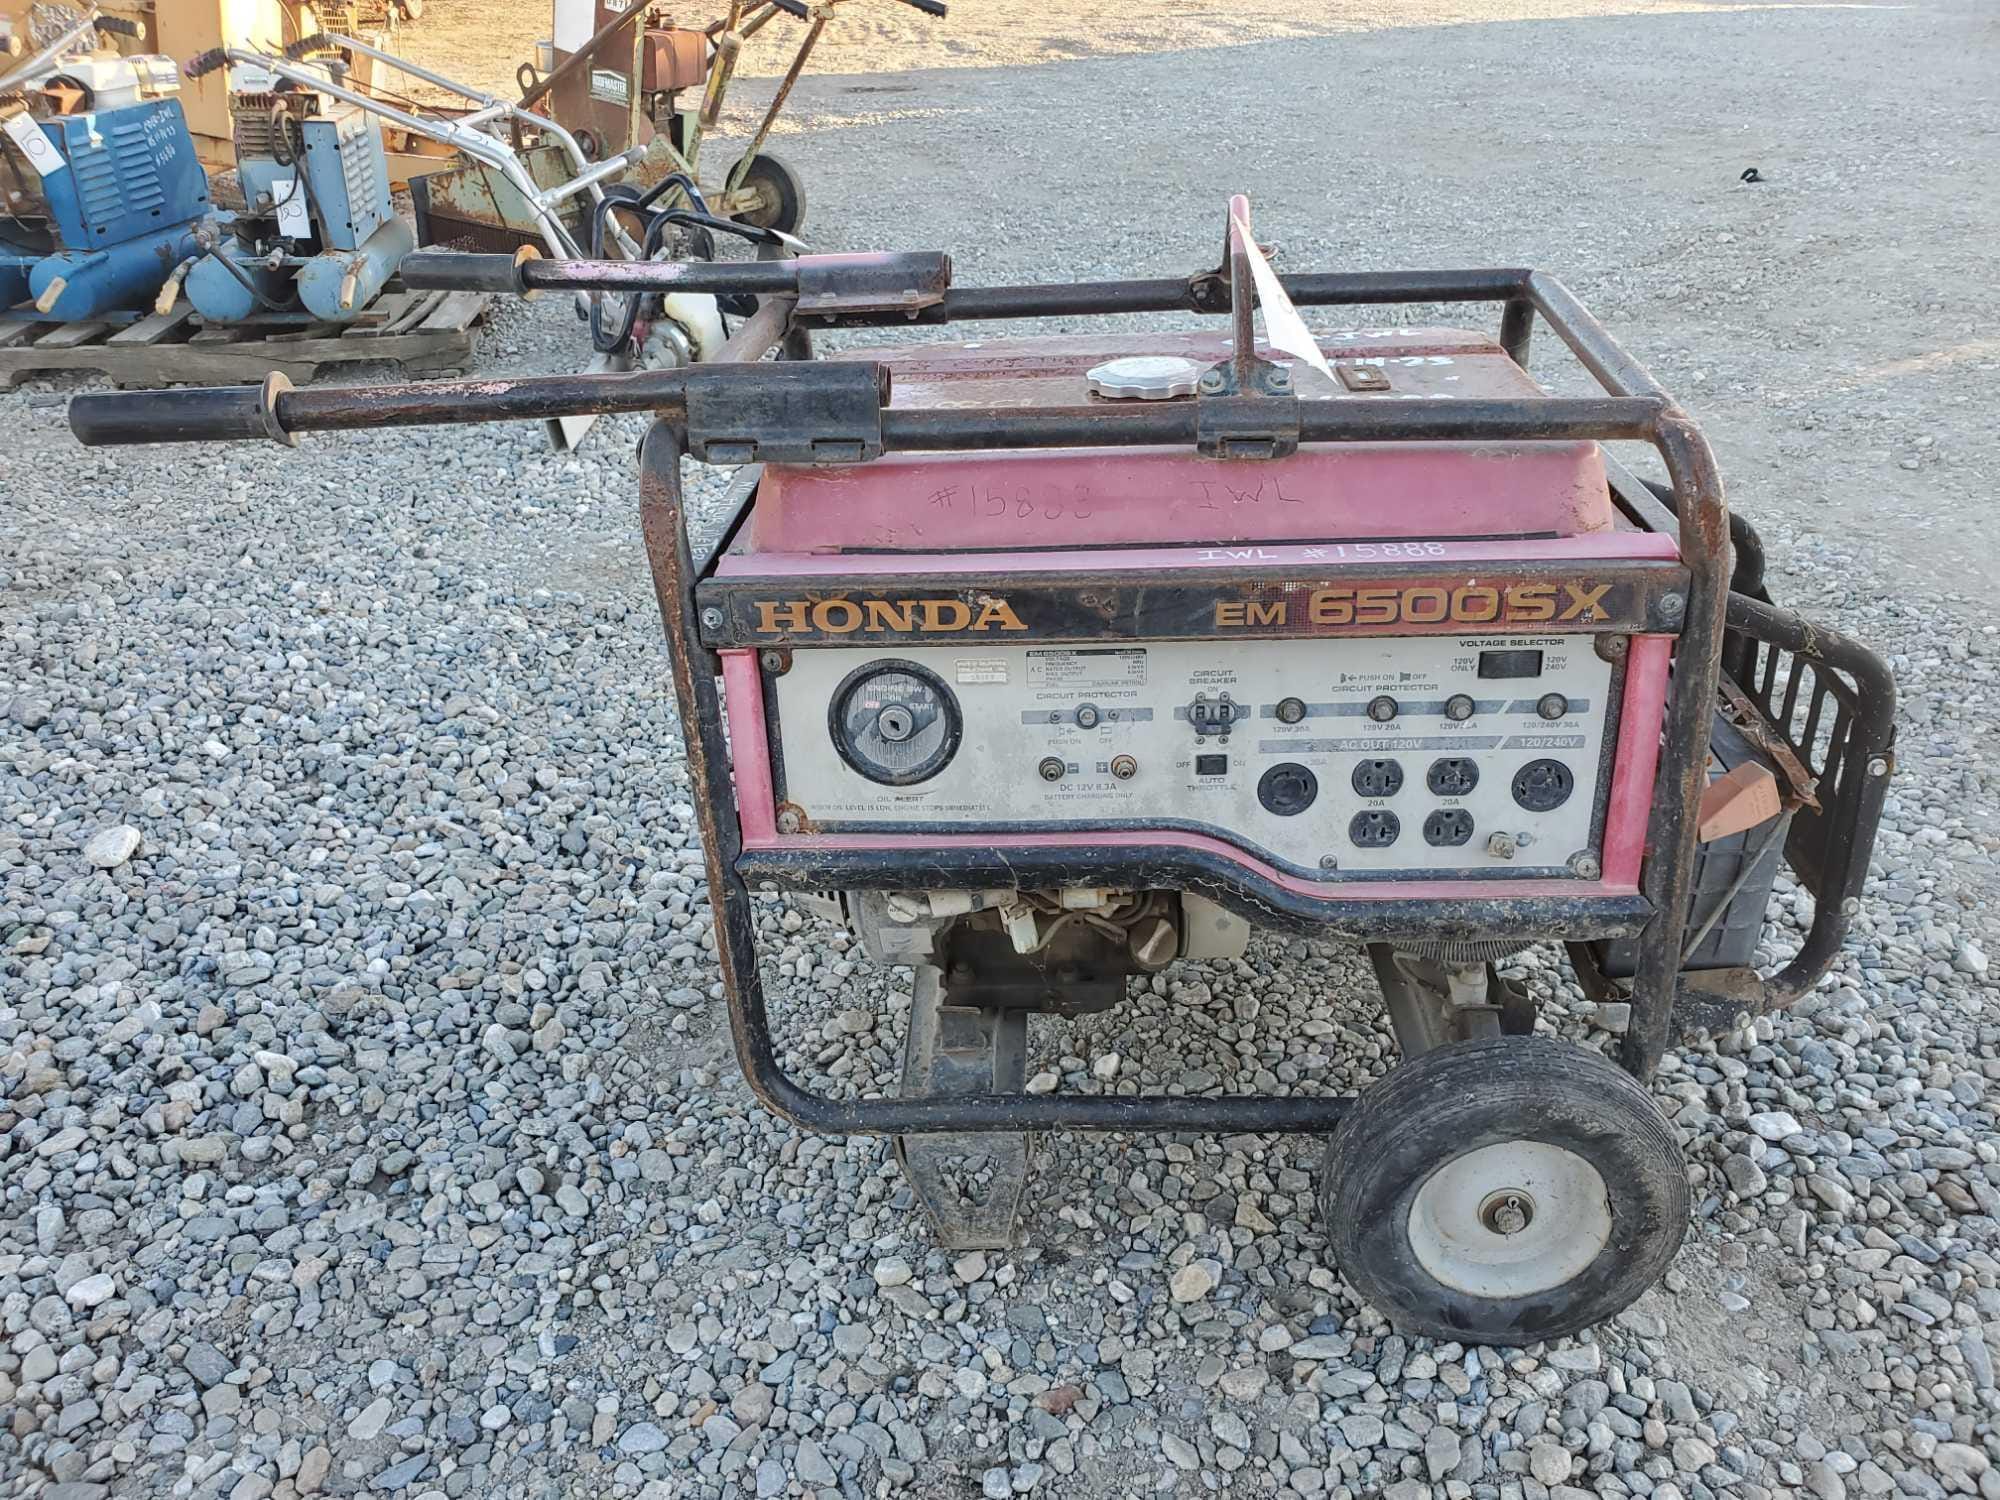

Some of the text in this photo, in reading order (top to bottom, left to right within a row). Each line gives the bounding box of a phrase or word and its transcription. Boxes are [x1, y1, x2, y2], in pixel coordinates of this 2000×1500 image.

[1188, 474, 1304, 510] IWL
[1197, 542, 1446, 561] IWL #15888
[753, 584, 1614, 634] HONDA EM 6500SX
[1459, 640, 1506, 648] VOLTAGE
[1451, 664, 1476, 672] ONLY
[1544, 663, 1567, 671] 240V
[1189, 677, 1237, 685] BREAKER
[1359, 673, 1381, 681] PUSH
[1375, 684, 1439, 692] PROTECTOR
[1036, 692, 1075, 700] CIRCUIT
[1340, 739, 1422, 749] AC OUT 120V
[1520, 737, 1577, 747] 120/240V
